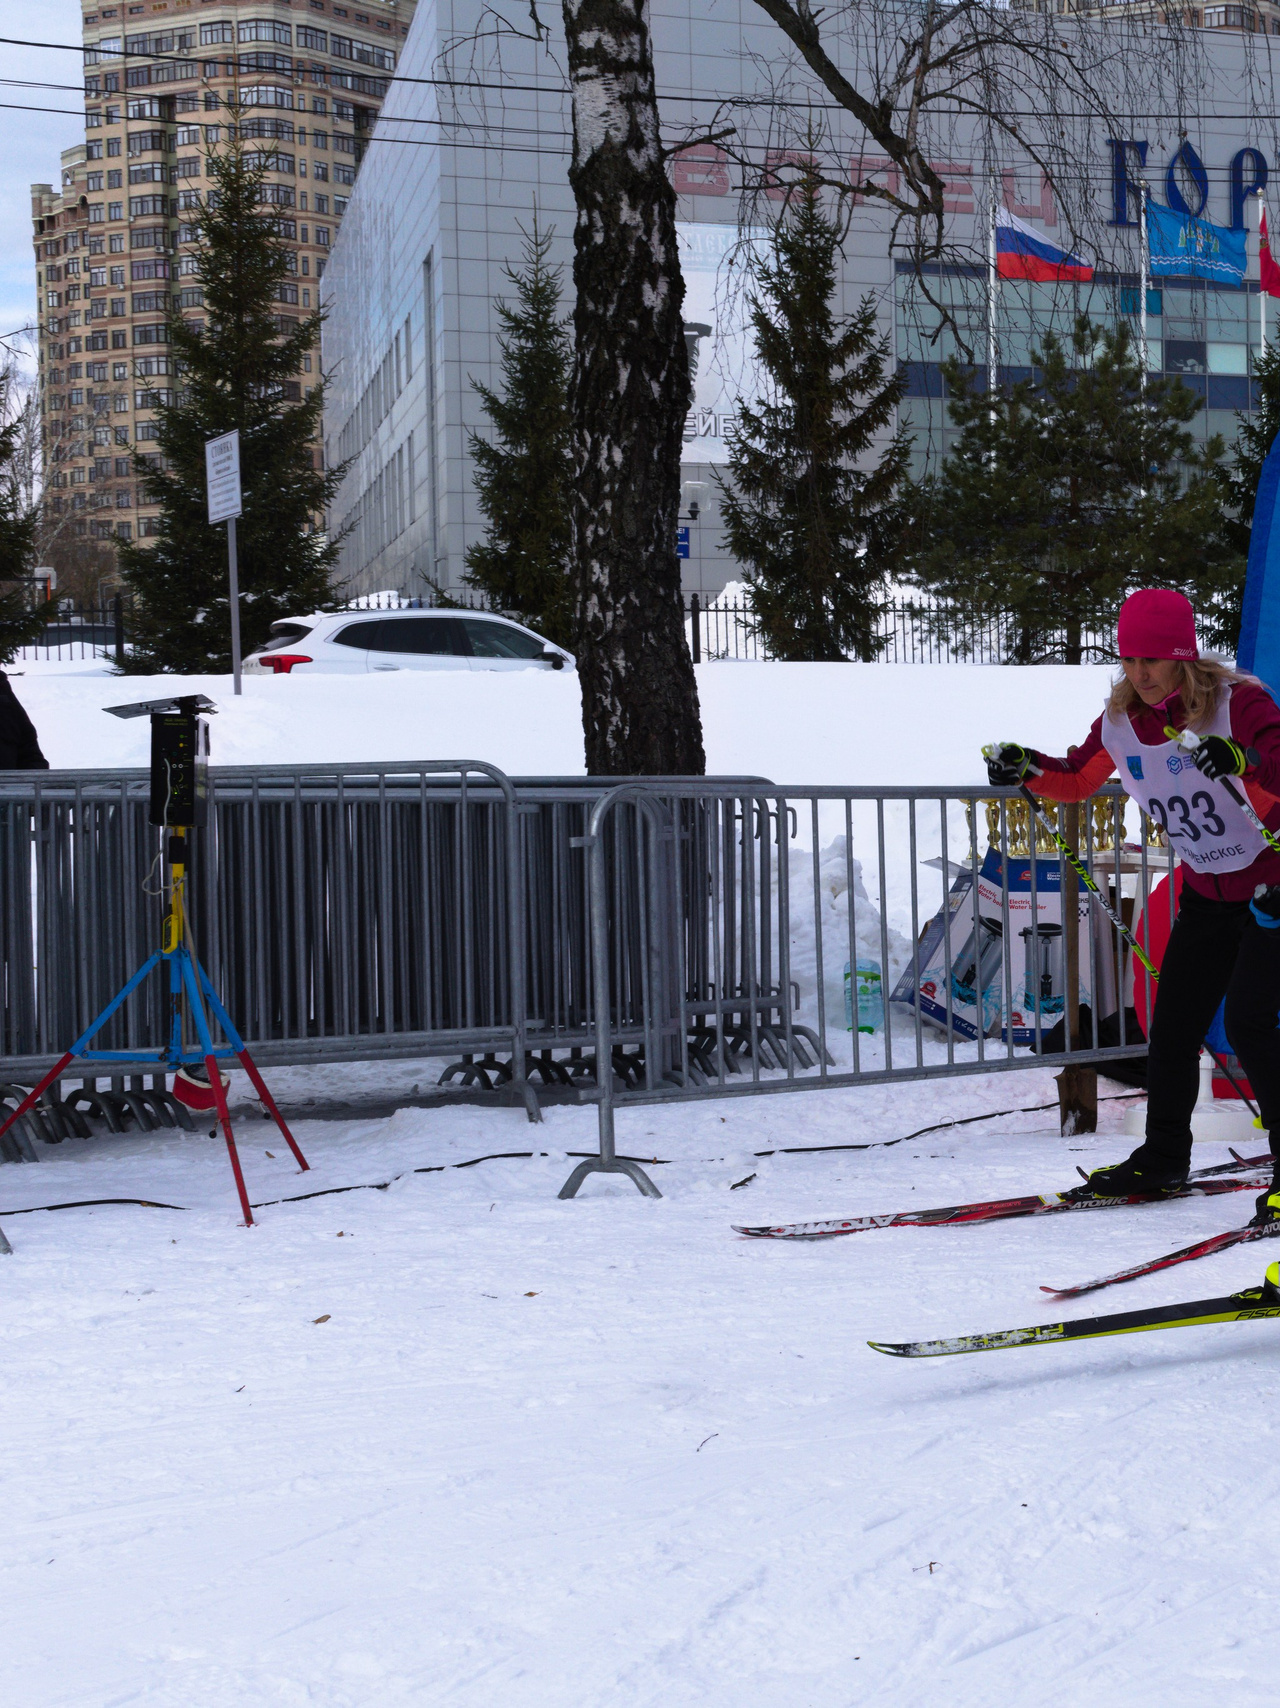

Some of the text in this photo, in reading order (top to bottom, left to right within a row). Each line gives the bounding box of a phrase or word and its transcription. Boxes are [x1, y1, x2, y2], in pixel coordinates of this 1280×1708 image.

[1148, 791, 1226, 842] 233
[978, 884, 997, 898] Electric
[1070, 1196, 1129, 1210] ATOMIC
